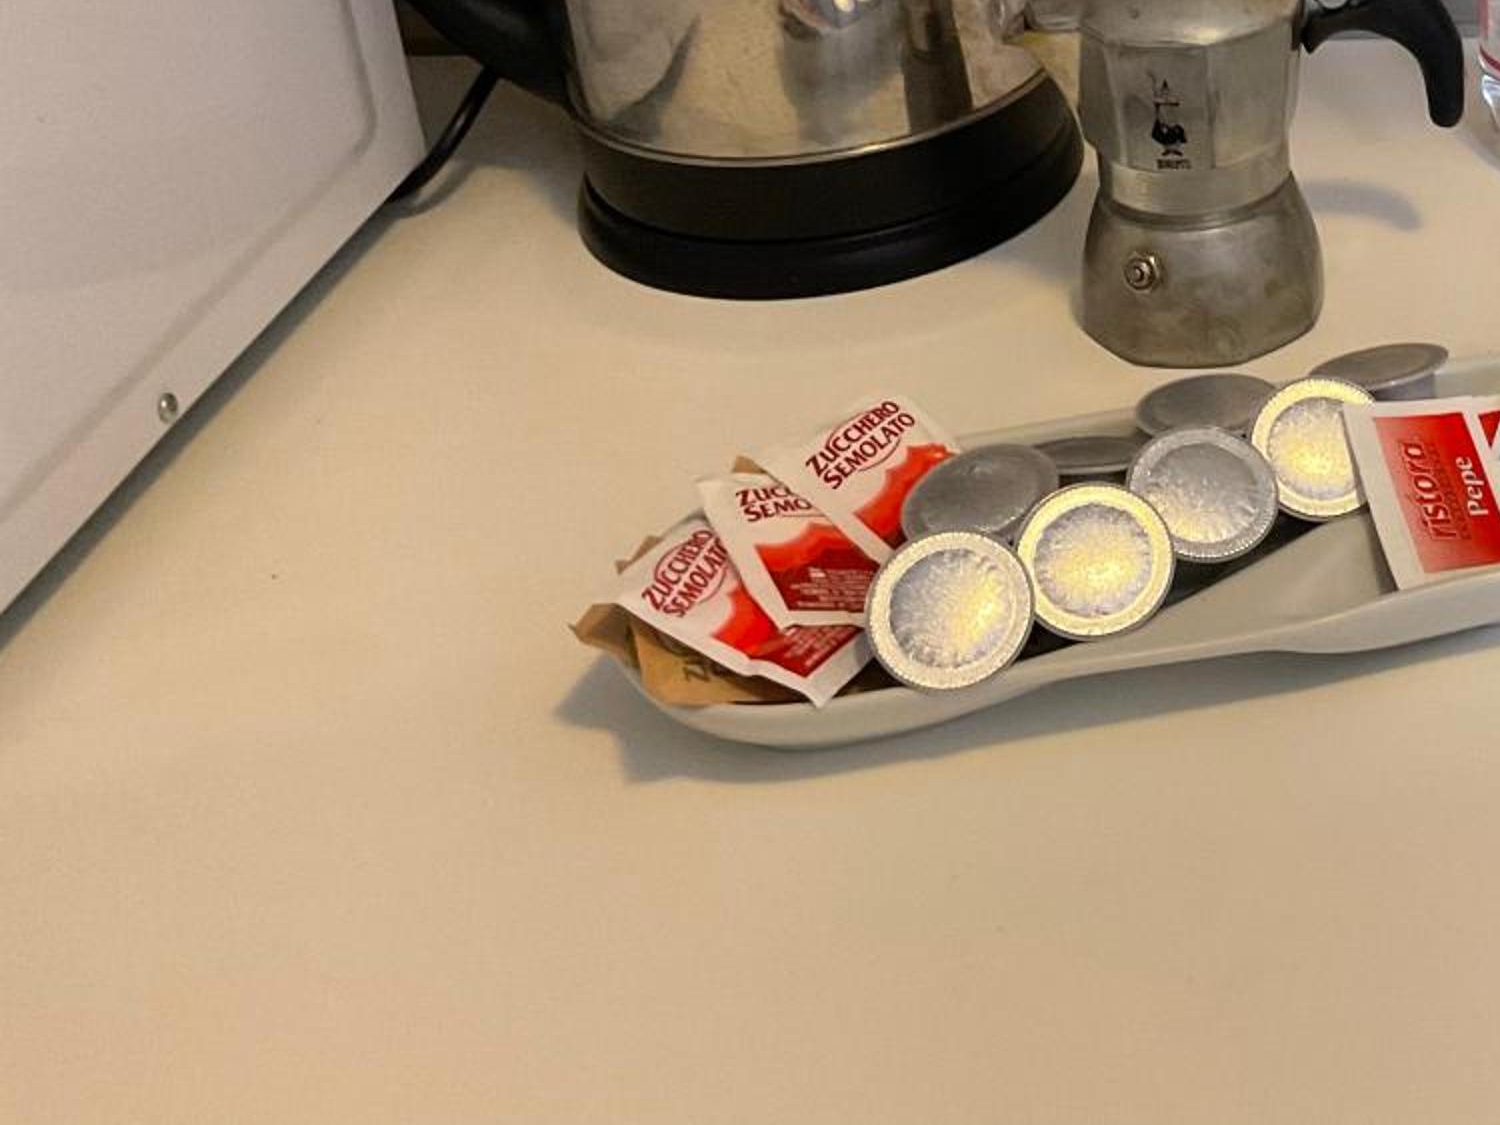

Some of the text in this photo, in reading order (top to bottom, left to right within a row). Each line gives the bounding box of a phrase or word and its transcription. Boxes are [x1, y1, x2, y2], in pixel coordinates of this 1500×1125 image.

[805, 400, 899, 480] ZUCCHERO
[824, 413, 915, 490] SEMOLATO
[1400, 441, 1458, 541] ristora
[1455, 456, 1489, 516] Pepe
[641, 530, 714, 611] ZUCCHERO
[663, 537, 727, 618] SEMOLAT
